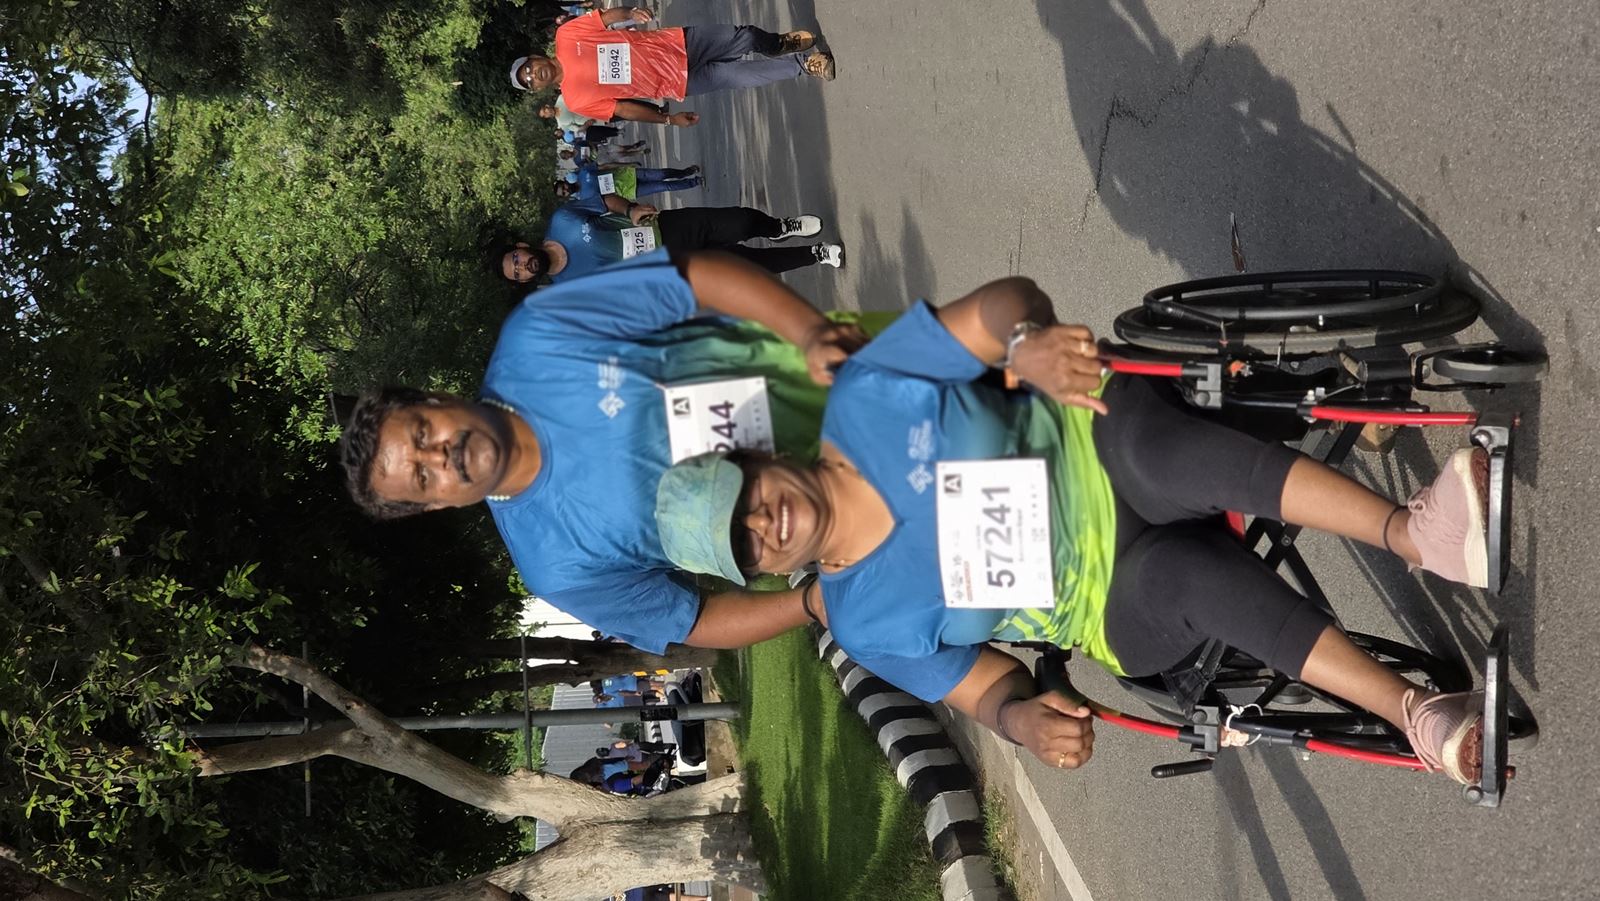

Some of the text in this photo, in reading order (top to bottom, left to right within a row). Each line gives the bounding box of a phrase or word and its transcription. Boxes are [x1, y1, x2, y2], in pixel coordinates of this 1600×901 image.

[610, 49, 620, 79] 50942
[673, 398, 690, 414] A
[943, 474, 961, 493] A
[980, 486, 1016, 588] 57241
